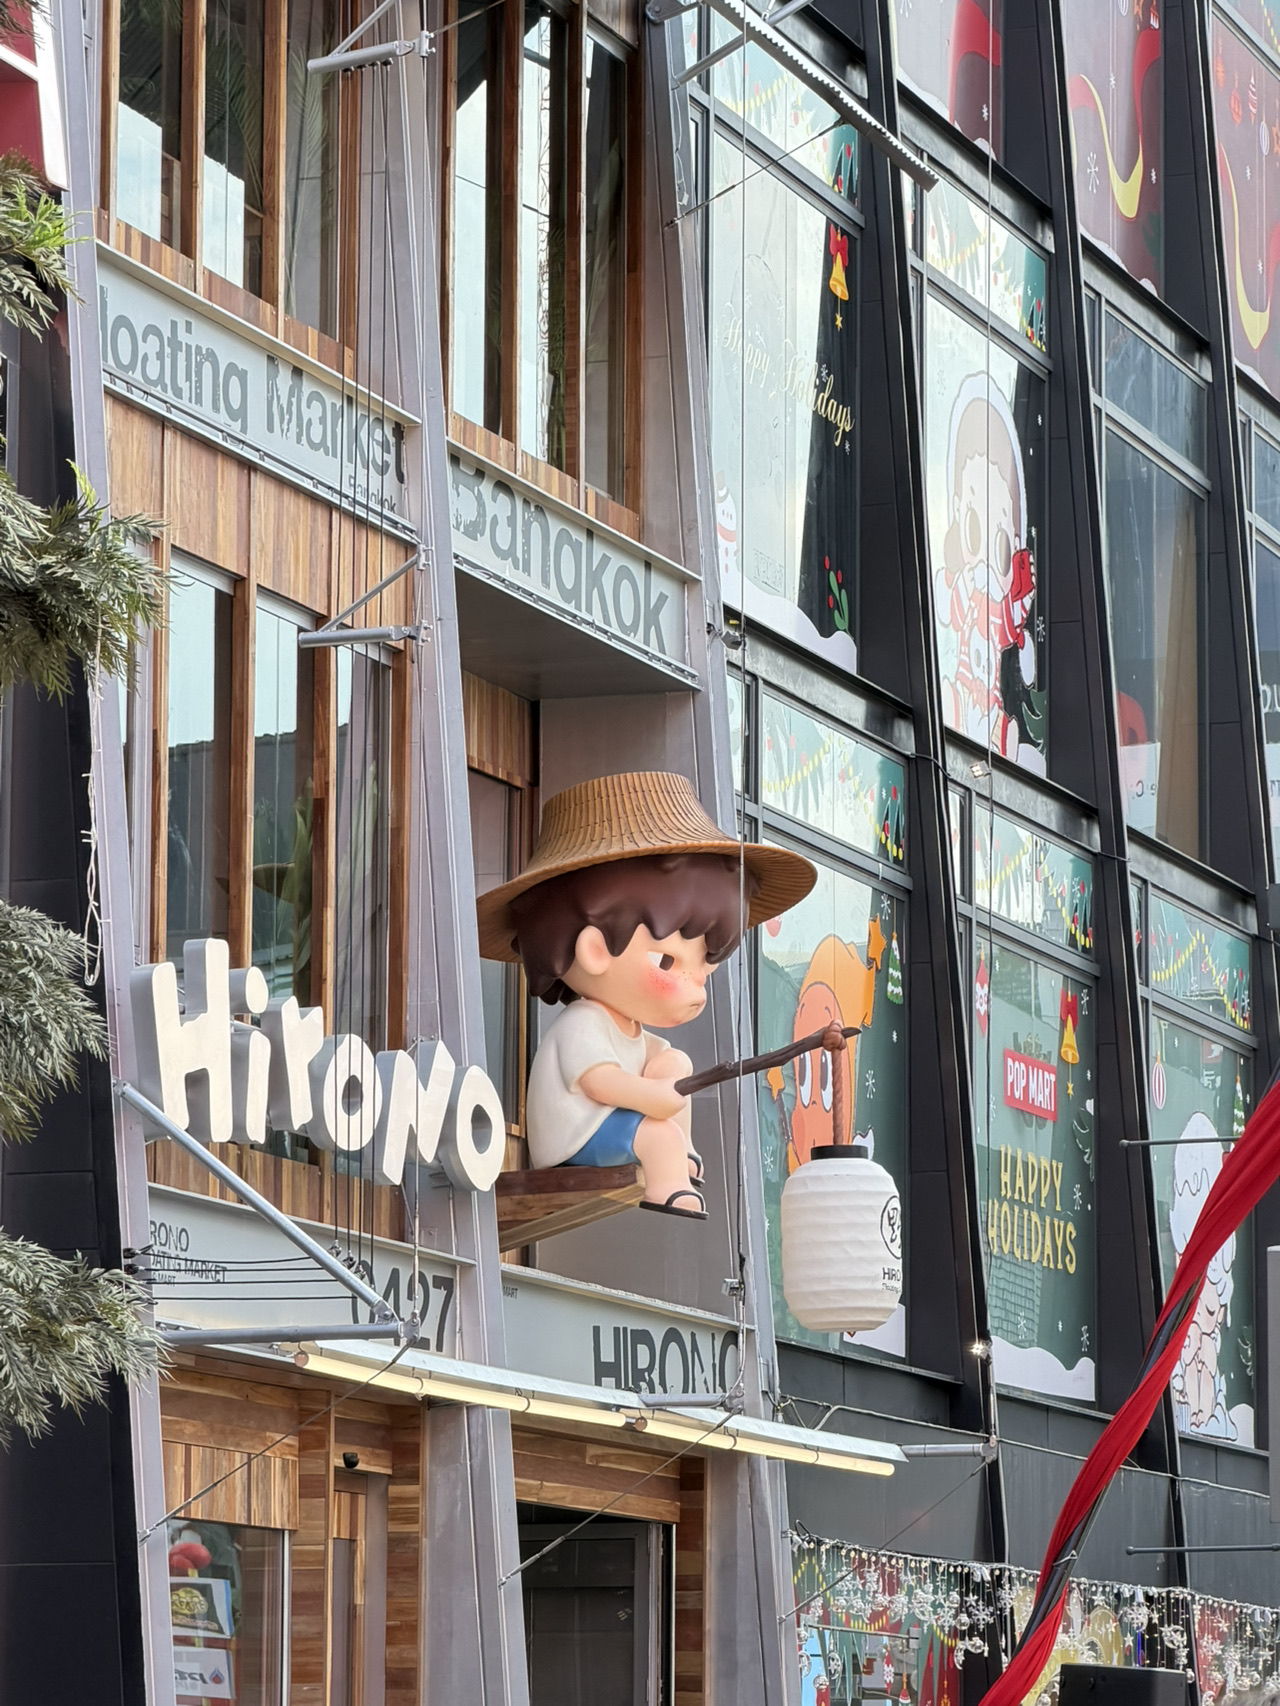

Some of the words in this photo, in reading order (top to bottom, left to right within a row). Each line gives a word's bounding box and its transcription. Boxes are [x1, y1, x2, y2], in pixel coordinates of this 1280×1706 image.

[266, 354, 405, 484] Market
[1007, 1057, 1027, 1101] POP
[1028, 1065, 1056, 1112] MART
[1000, 1144, 1063, 1211] HAPPY
[988, 1198, 1076, 1275] HOLIDAYS
